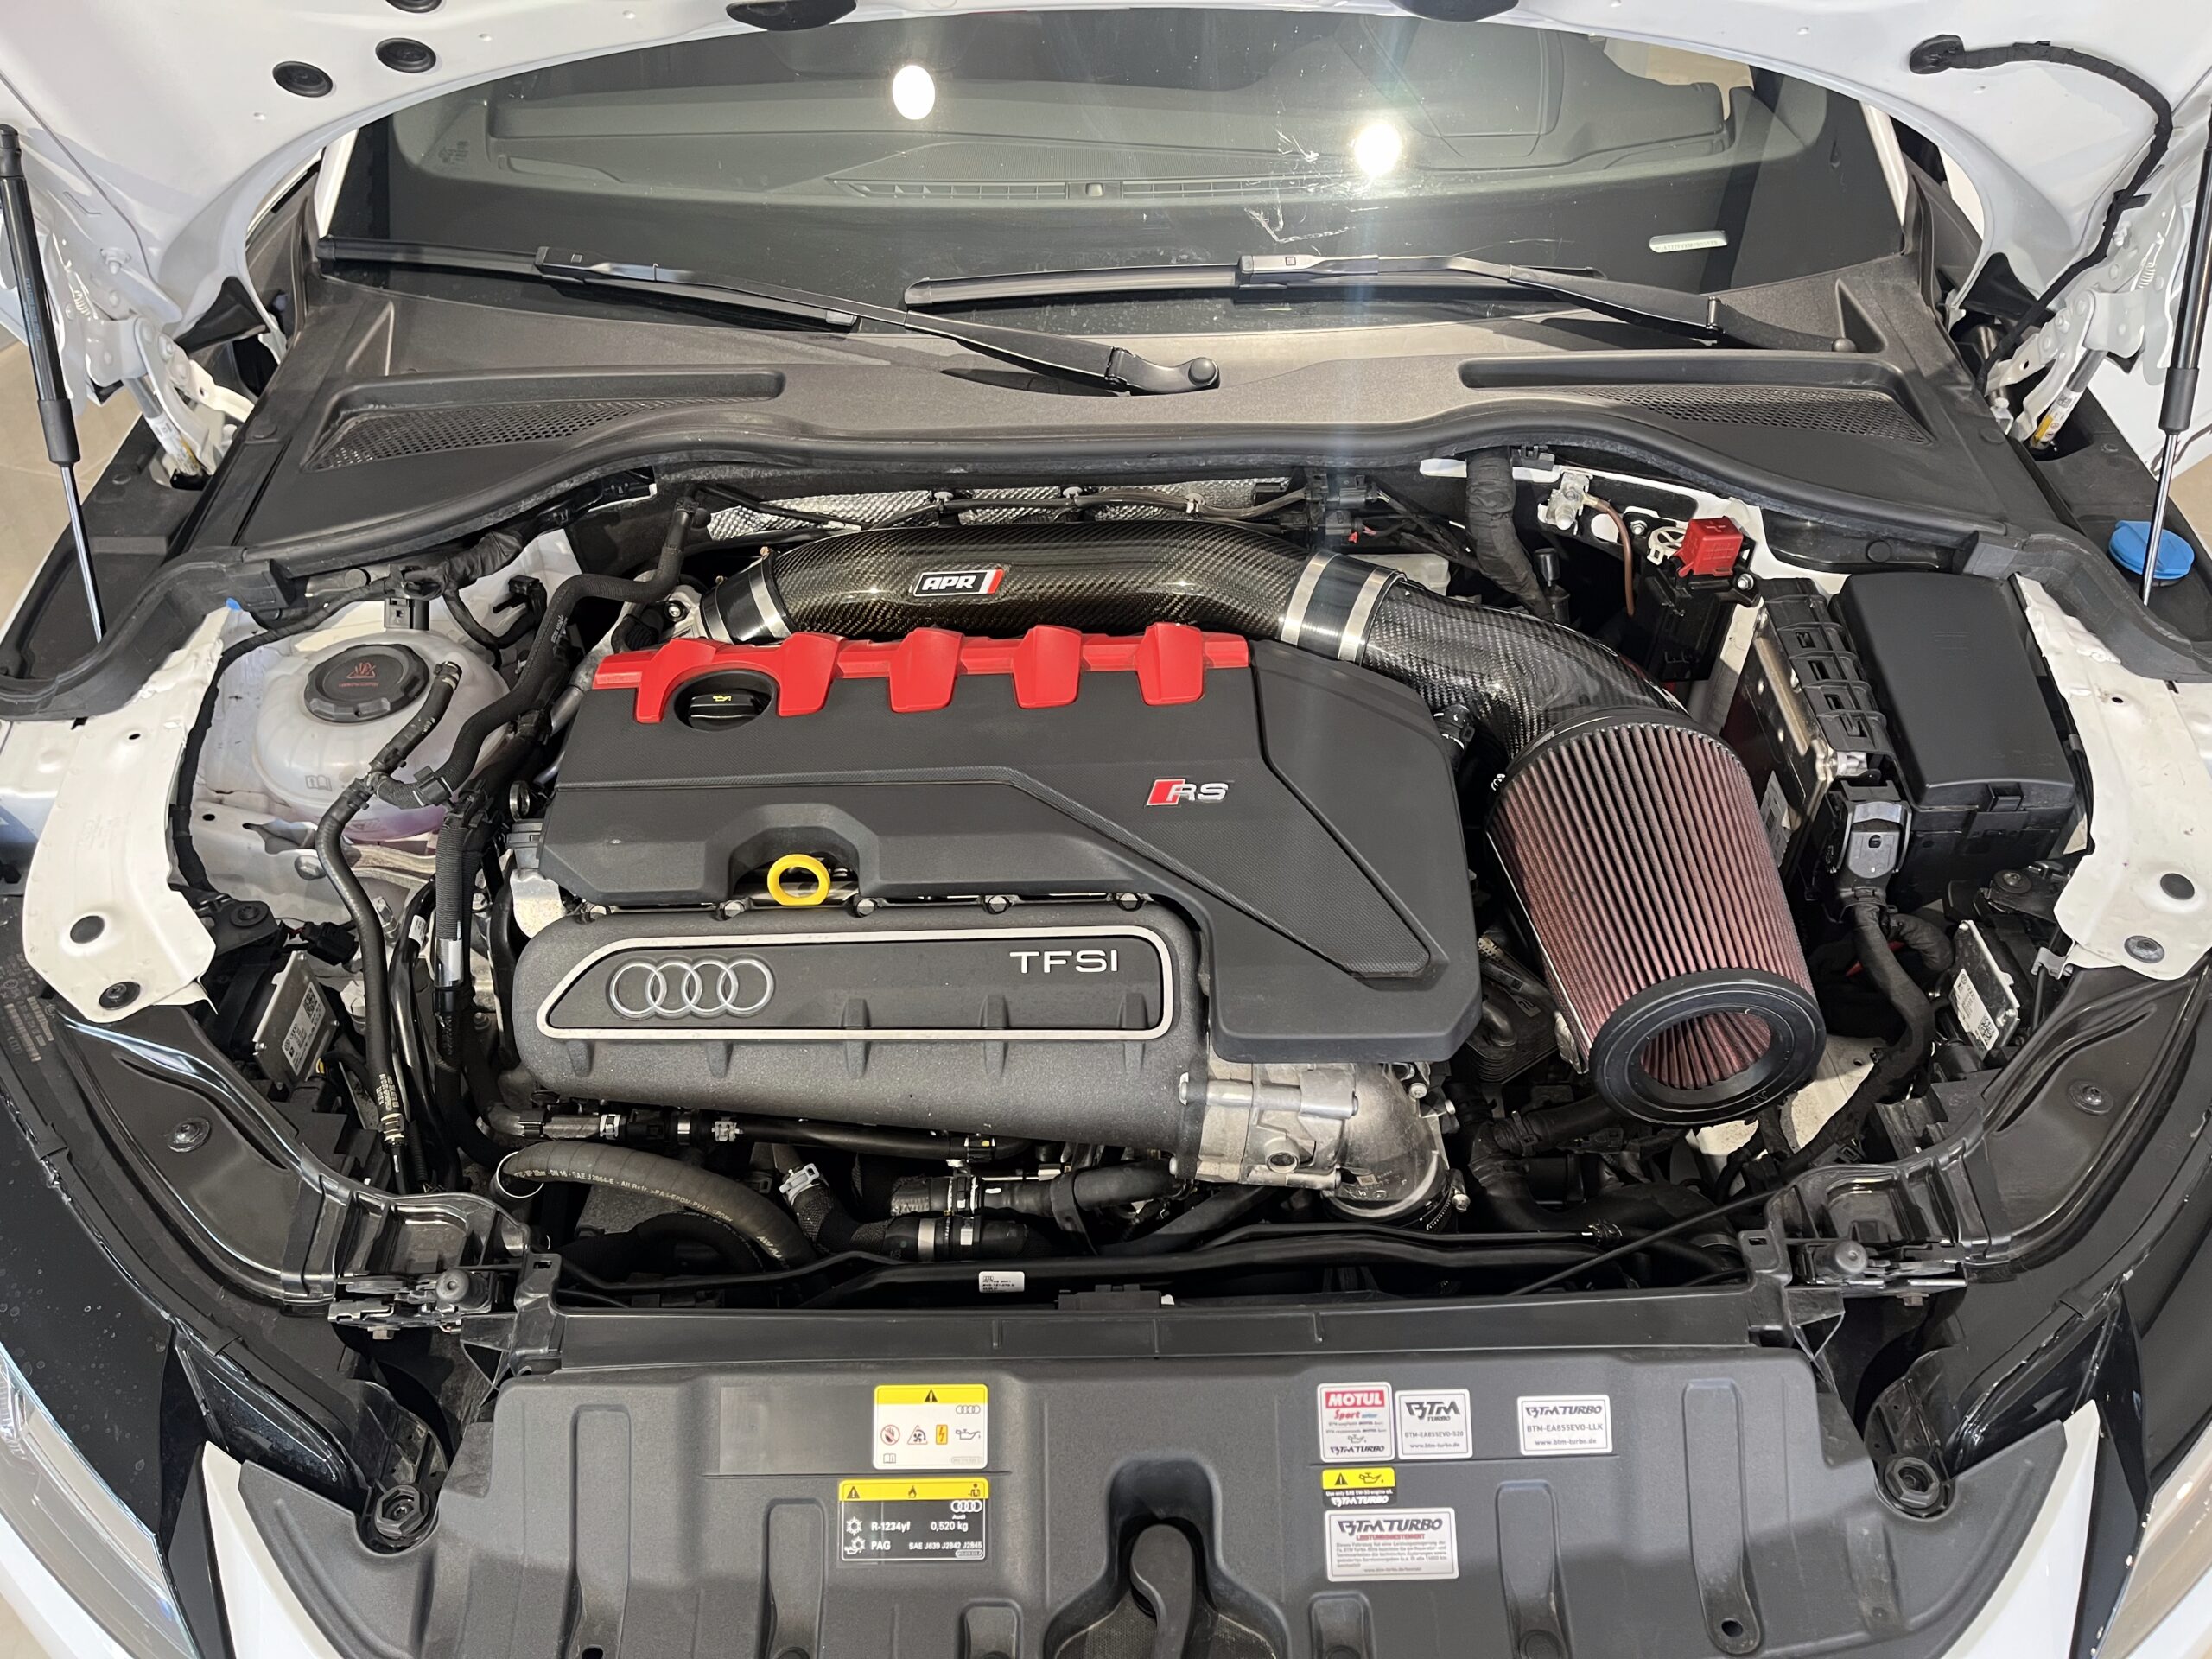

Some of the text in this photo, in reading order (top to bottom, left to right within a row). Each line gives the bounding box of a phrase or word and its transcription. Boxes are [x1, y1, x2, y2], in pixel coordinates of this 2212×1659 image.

[921, 575, 976, 590] APR
[1166, 782, 1229, 803] RS
[1009, 950, 1119, 974] TFSI
[1328, 1392, 1382, 1407] MOTUL
[1334, 1408, 1361, 1421] Sport
[871, 1521, 969, 1533] R-1234yf 0,520 kg
[871, 1541, 891, 1550] PAG
[908, 1541, 923, 1550] SAE
[924, 1541, 941, 1550] J639
